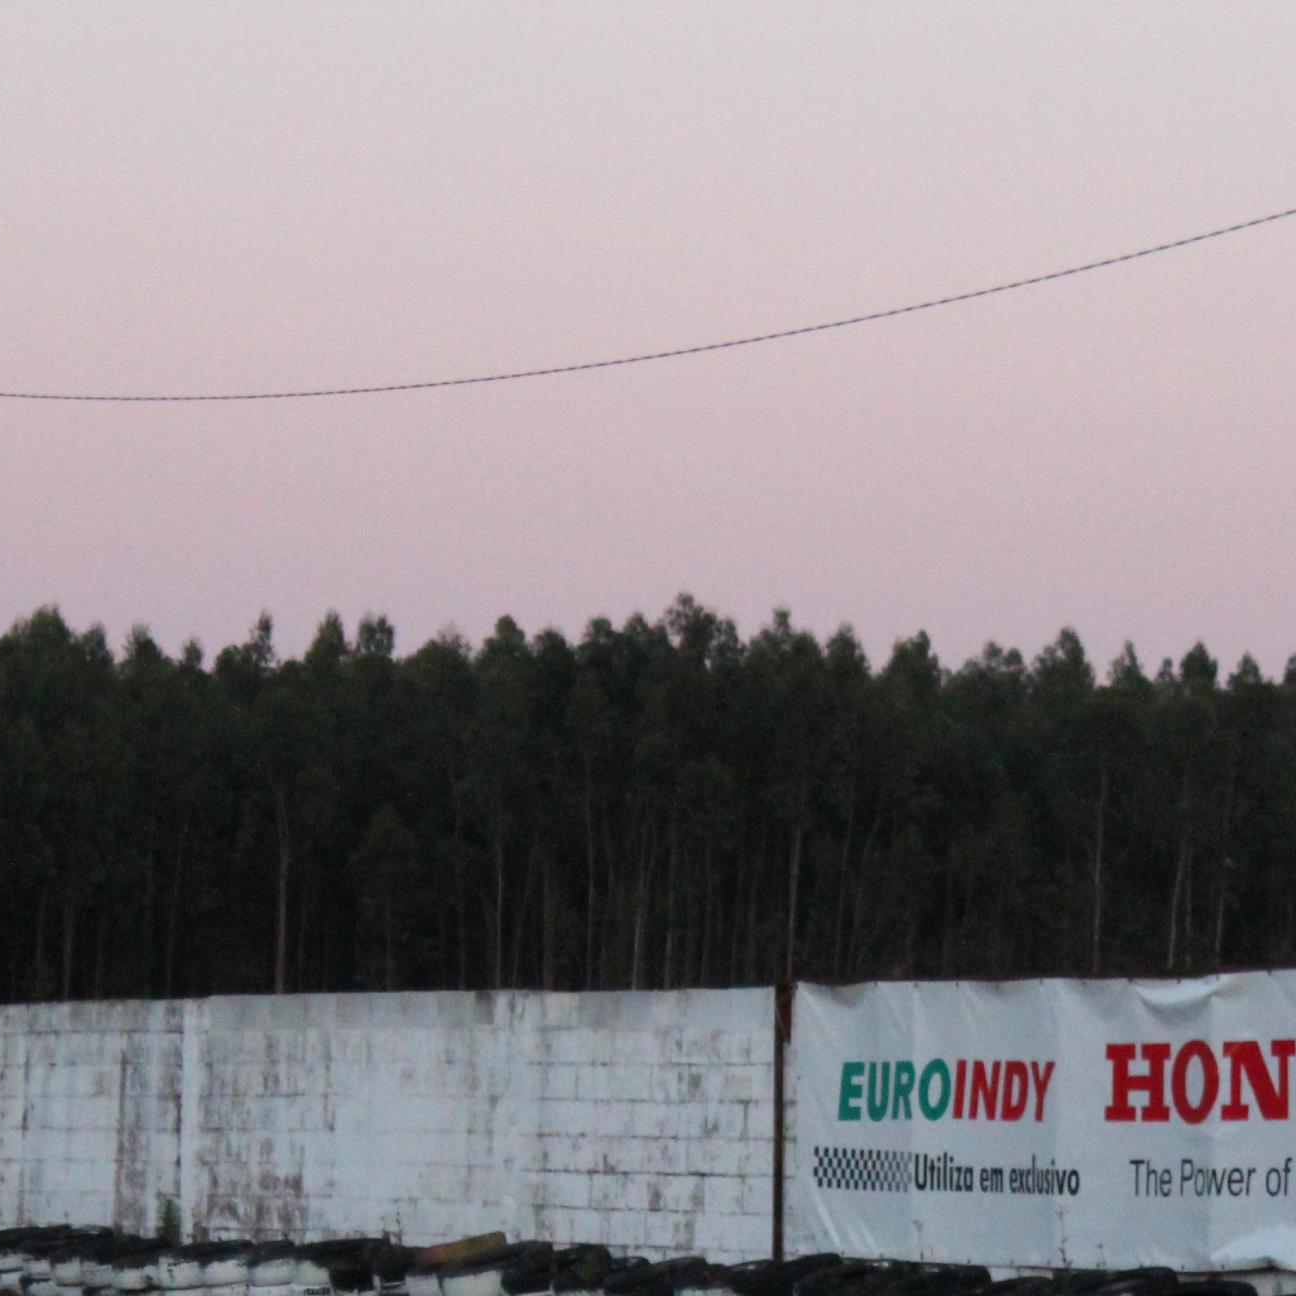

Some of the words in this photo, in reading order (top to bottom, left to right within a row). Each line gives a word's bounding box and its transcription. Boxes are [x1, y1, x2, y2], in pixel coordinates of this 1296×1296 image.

[838, 1060, 1054, 1121] EUROINDY
[914, 1152, 973, 1192] Utiliza
[979, 1167, 1007, 1193] em
[1008, 1155, 1081, 1197] exclusivo
[1130, 1159, 1173, 1198] The
[1180, 1158, 1257, 1198] Power
[1265, 1157, 1294, 1198] of
